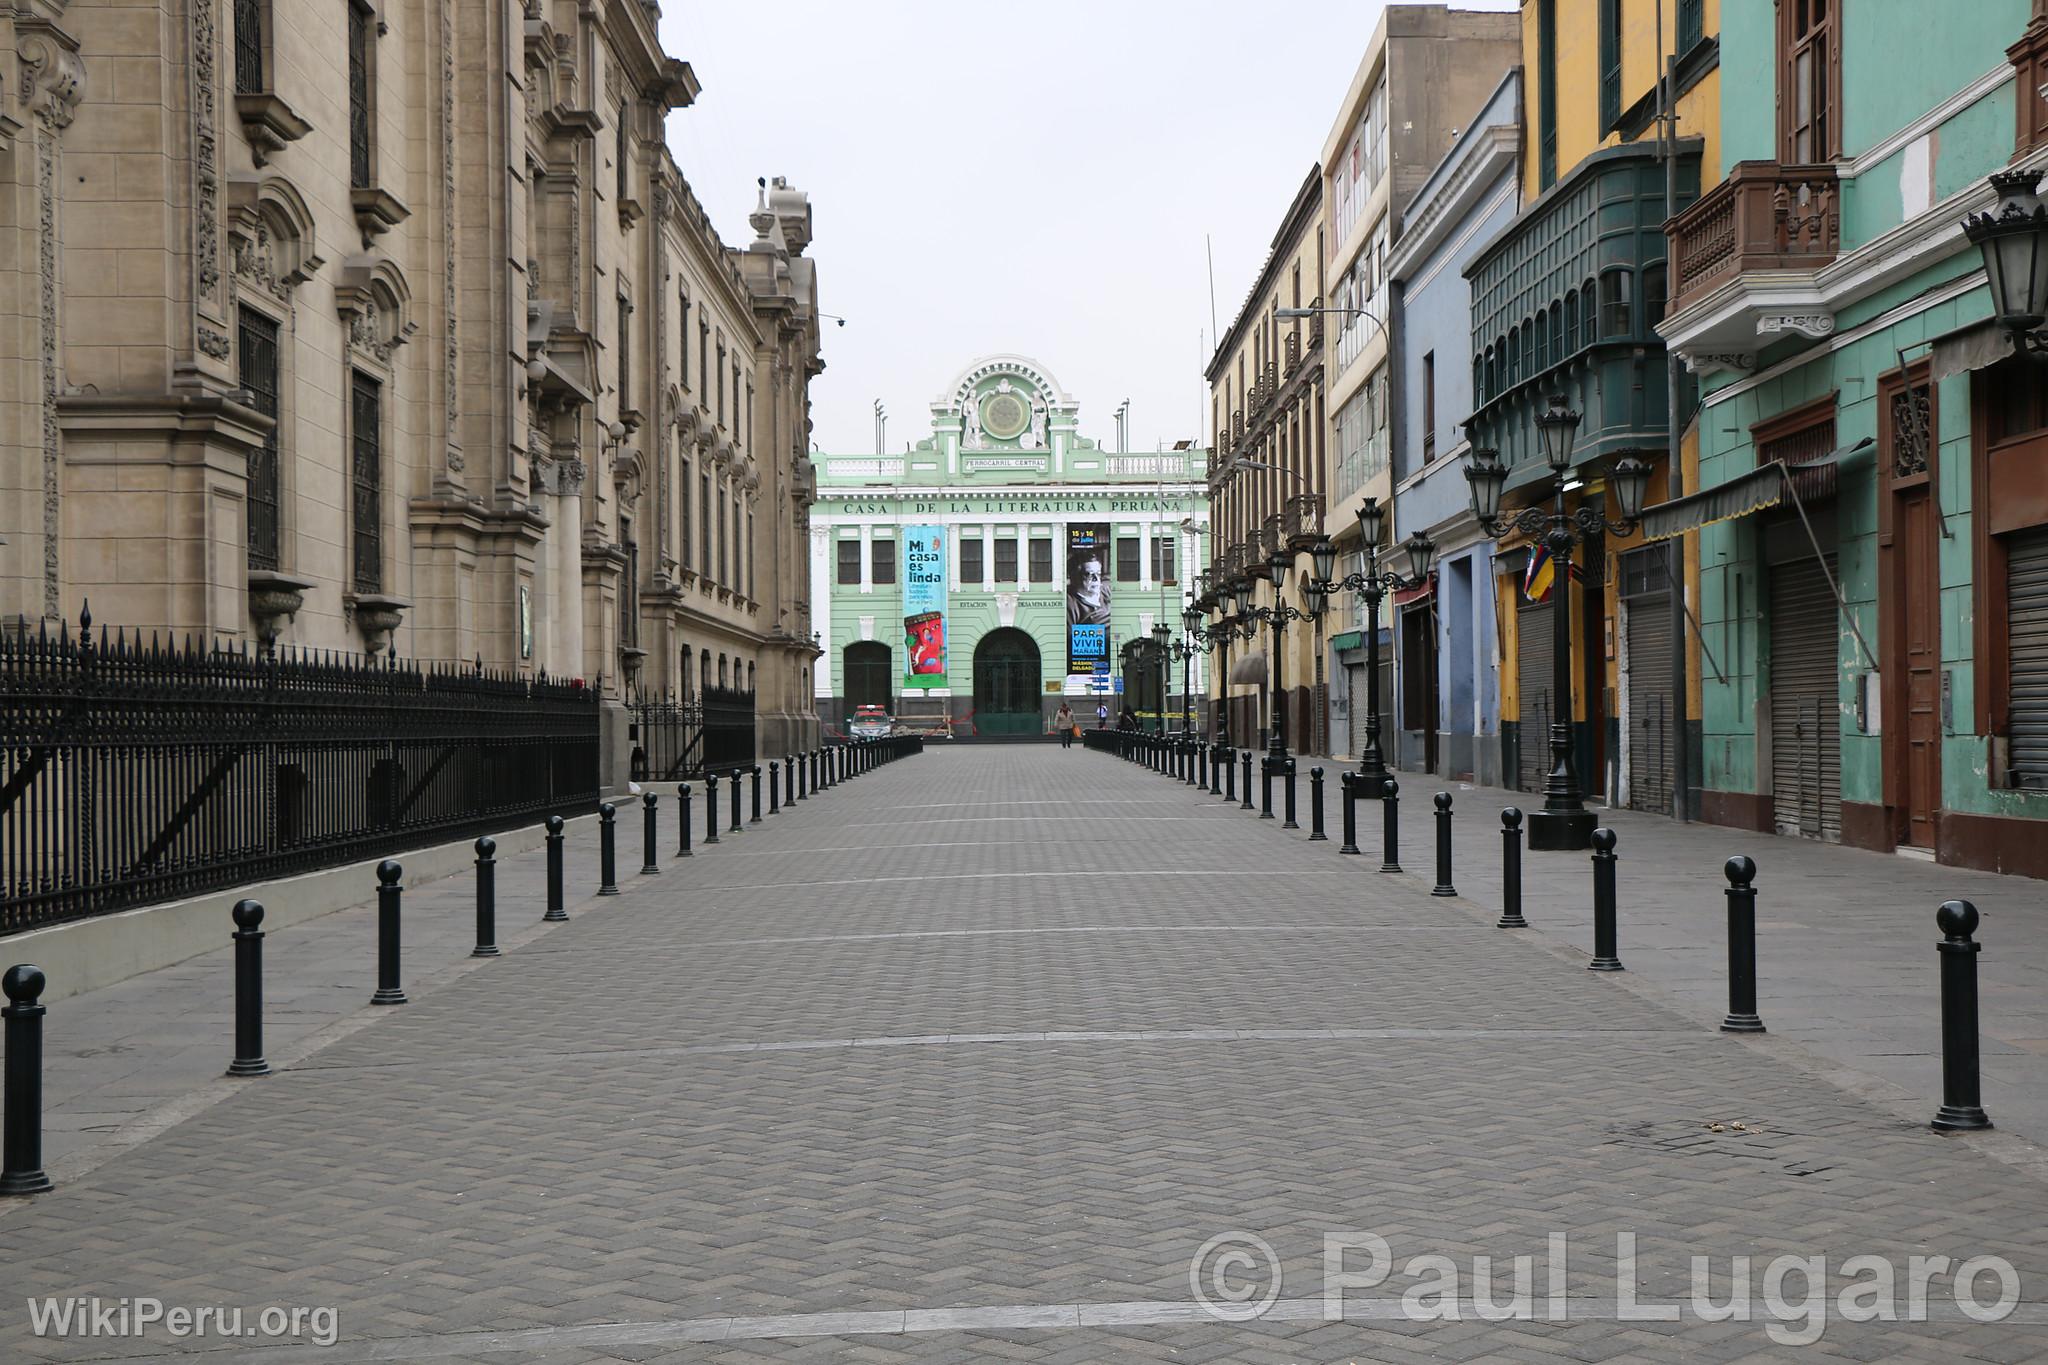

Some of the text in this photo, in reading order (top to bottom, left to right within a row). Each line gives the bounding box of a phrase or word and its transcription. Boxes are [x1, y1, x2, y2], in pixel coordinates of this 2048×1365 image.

[844, 501, 1181, 514] CASA DE LA LITERATURA PERUANA
[909, 540, 924, 552] Mi
[909, 553, 939, 562] casa
[909, 562, 924, 571] es
[908, 572, 941, 583] linda
[1073, 630, 1103, 638] PARA
[1074, 639, 1103, 647] VIVIR
